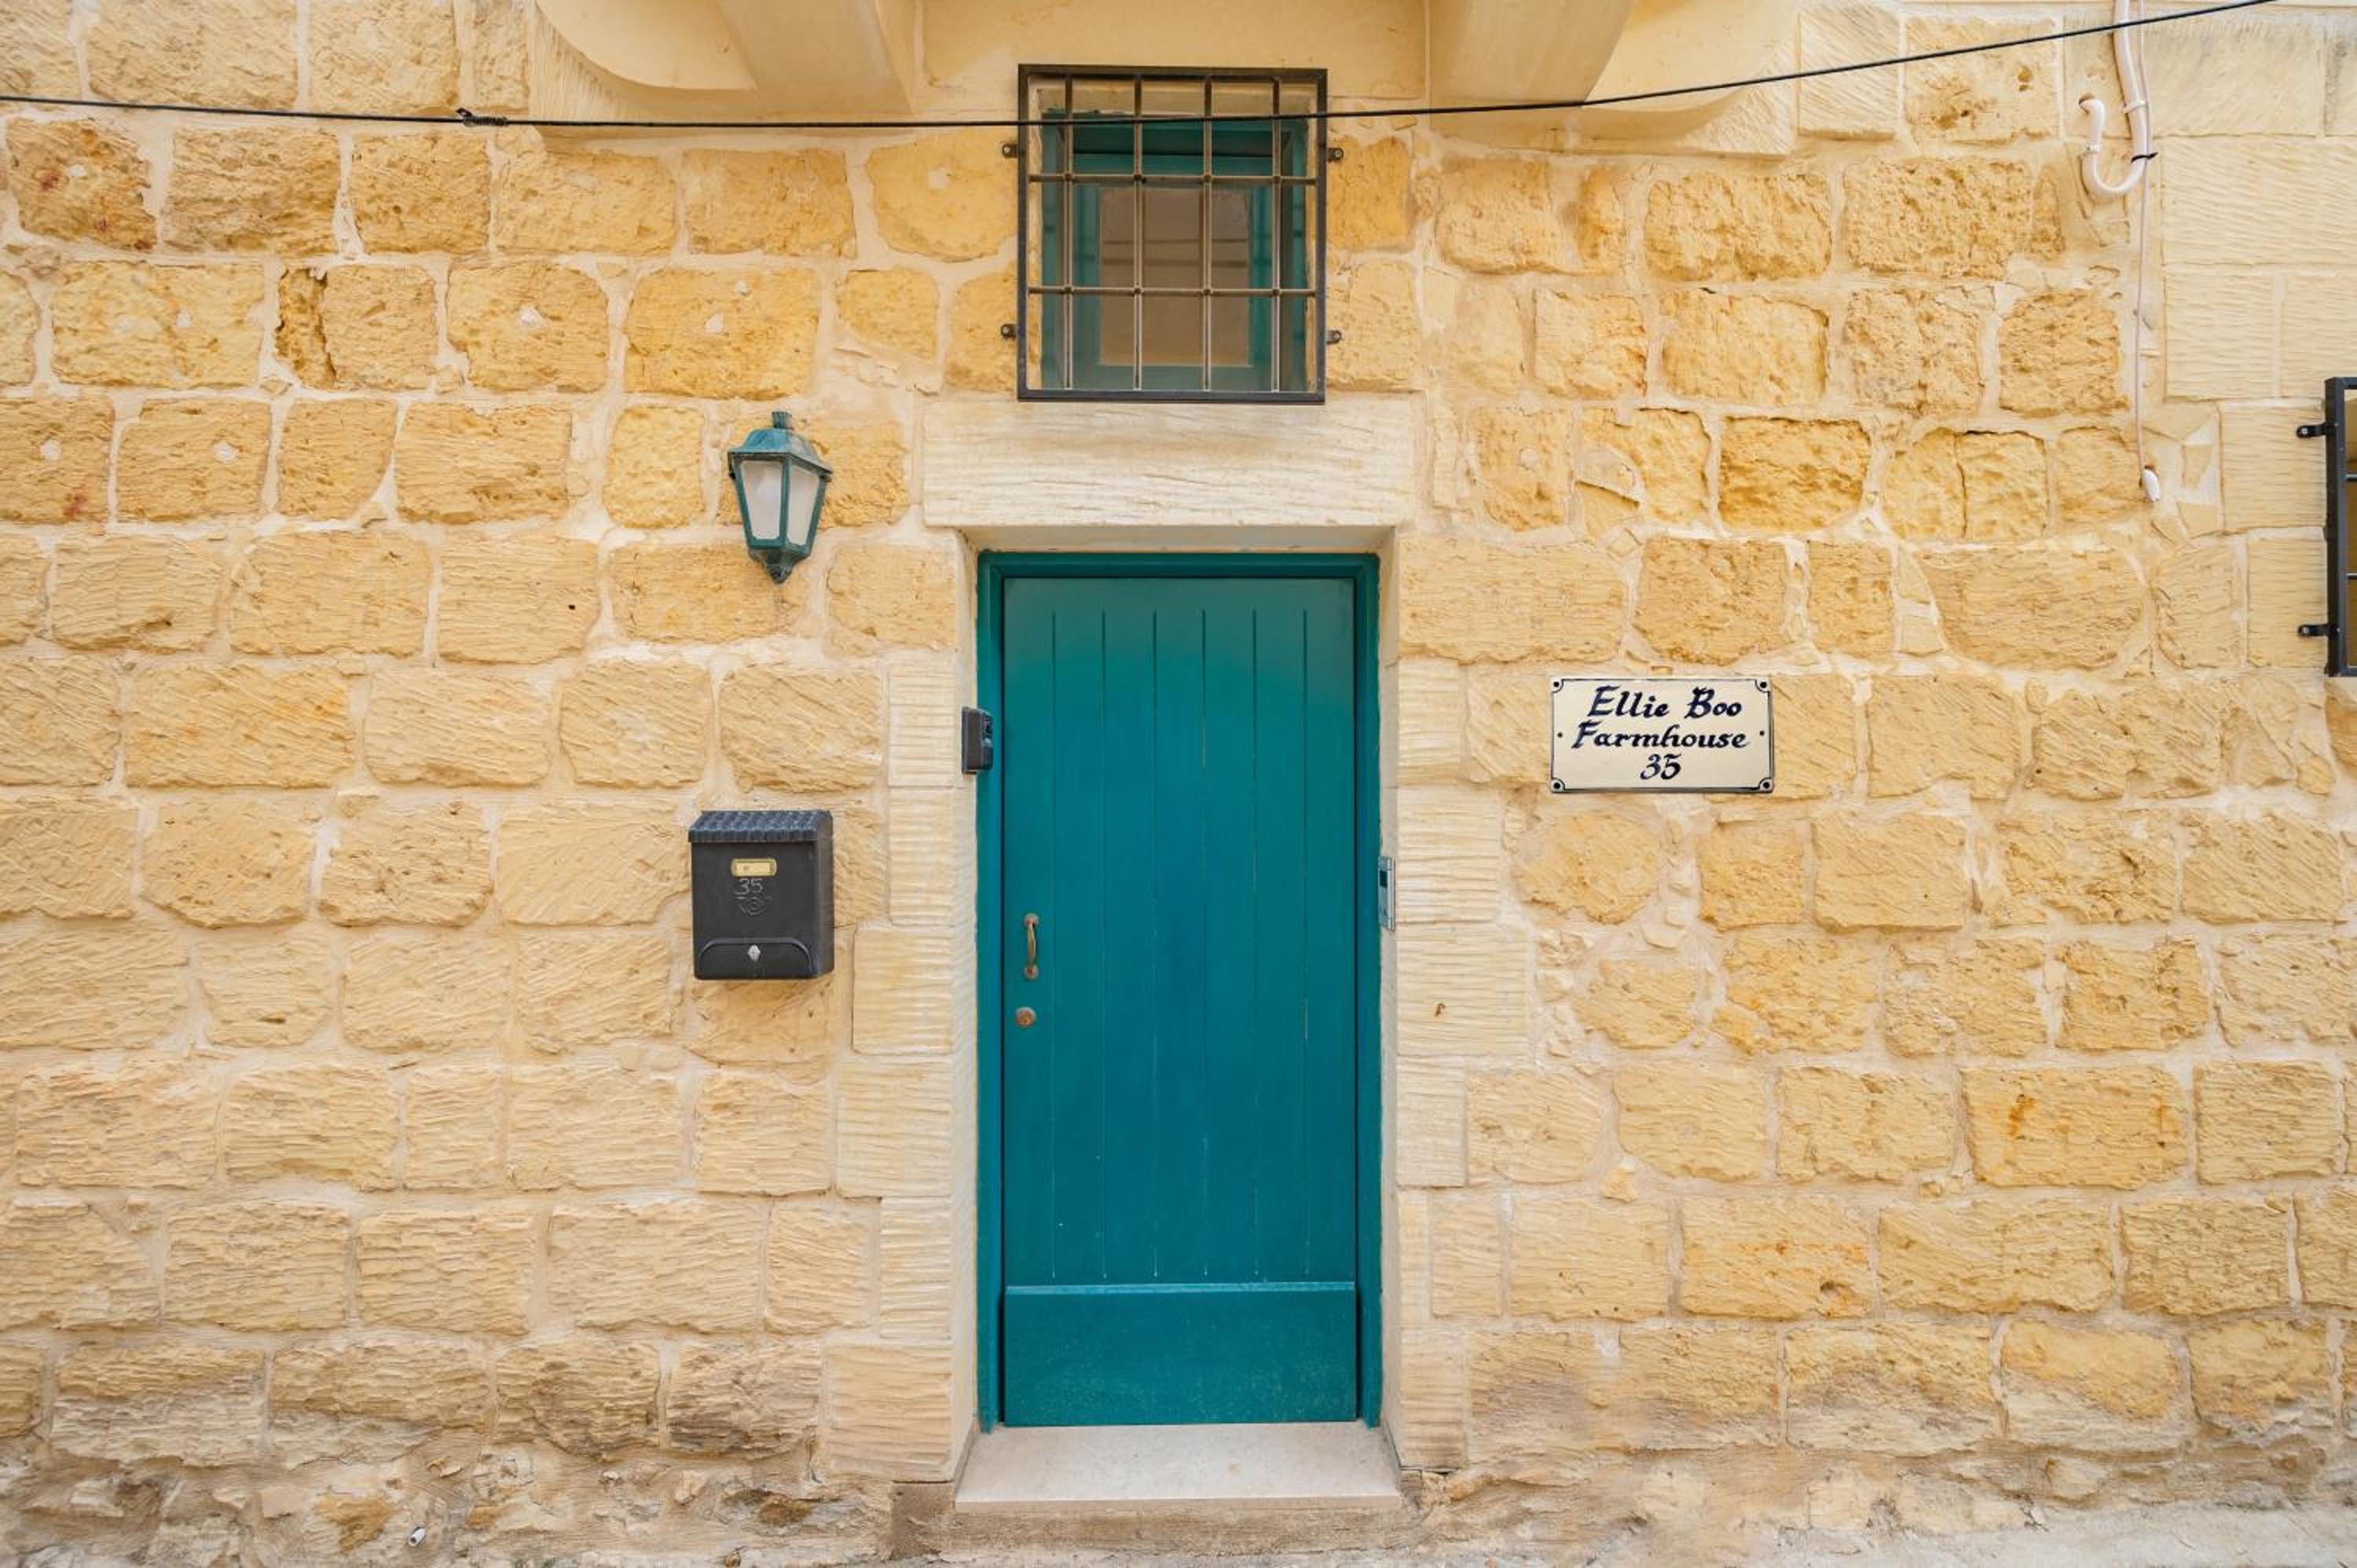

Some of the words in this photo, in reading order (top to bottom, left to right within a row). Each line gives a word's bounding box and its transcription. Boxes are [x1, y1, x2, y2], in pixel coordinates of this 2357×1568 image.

[1587, 685, 1670, 718] Ellie
[1684, 687, 1742, 719] Boo
[1571, 720, 1748, 749] Farmhouse
[1640, 753, 1682, 779] 35
[736, 877, 764, 894] 35
